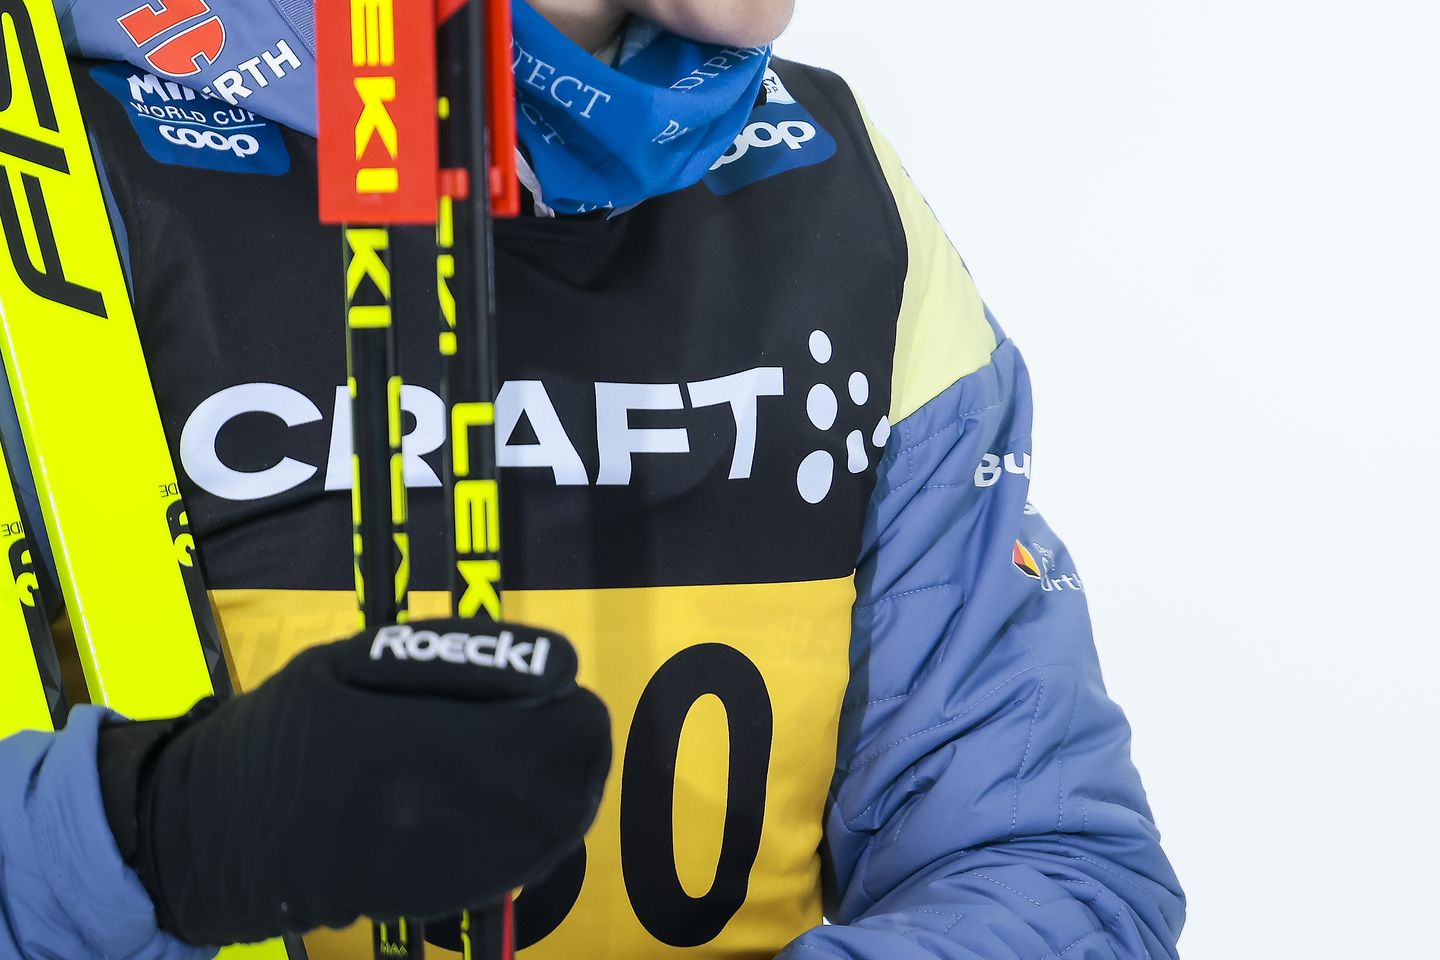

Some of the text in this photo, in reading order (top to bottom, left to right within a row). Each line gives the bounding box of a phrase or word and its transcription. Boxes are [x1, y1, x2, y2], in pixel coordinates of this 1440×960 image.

[202, 39, 302, 106] RTH
[512, 43, 611, 119] TECT
[130, 101, 206, 124] WORLD
[158, 124, 260, 158] coop
[708, 120, 817, 171] oop
[179, 366, 784, 501] CRAFT
[973, 452, 1031, 488] Bu
[451, 402, 502, 622] LEK
